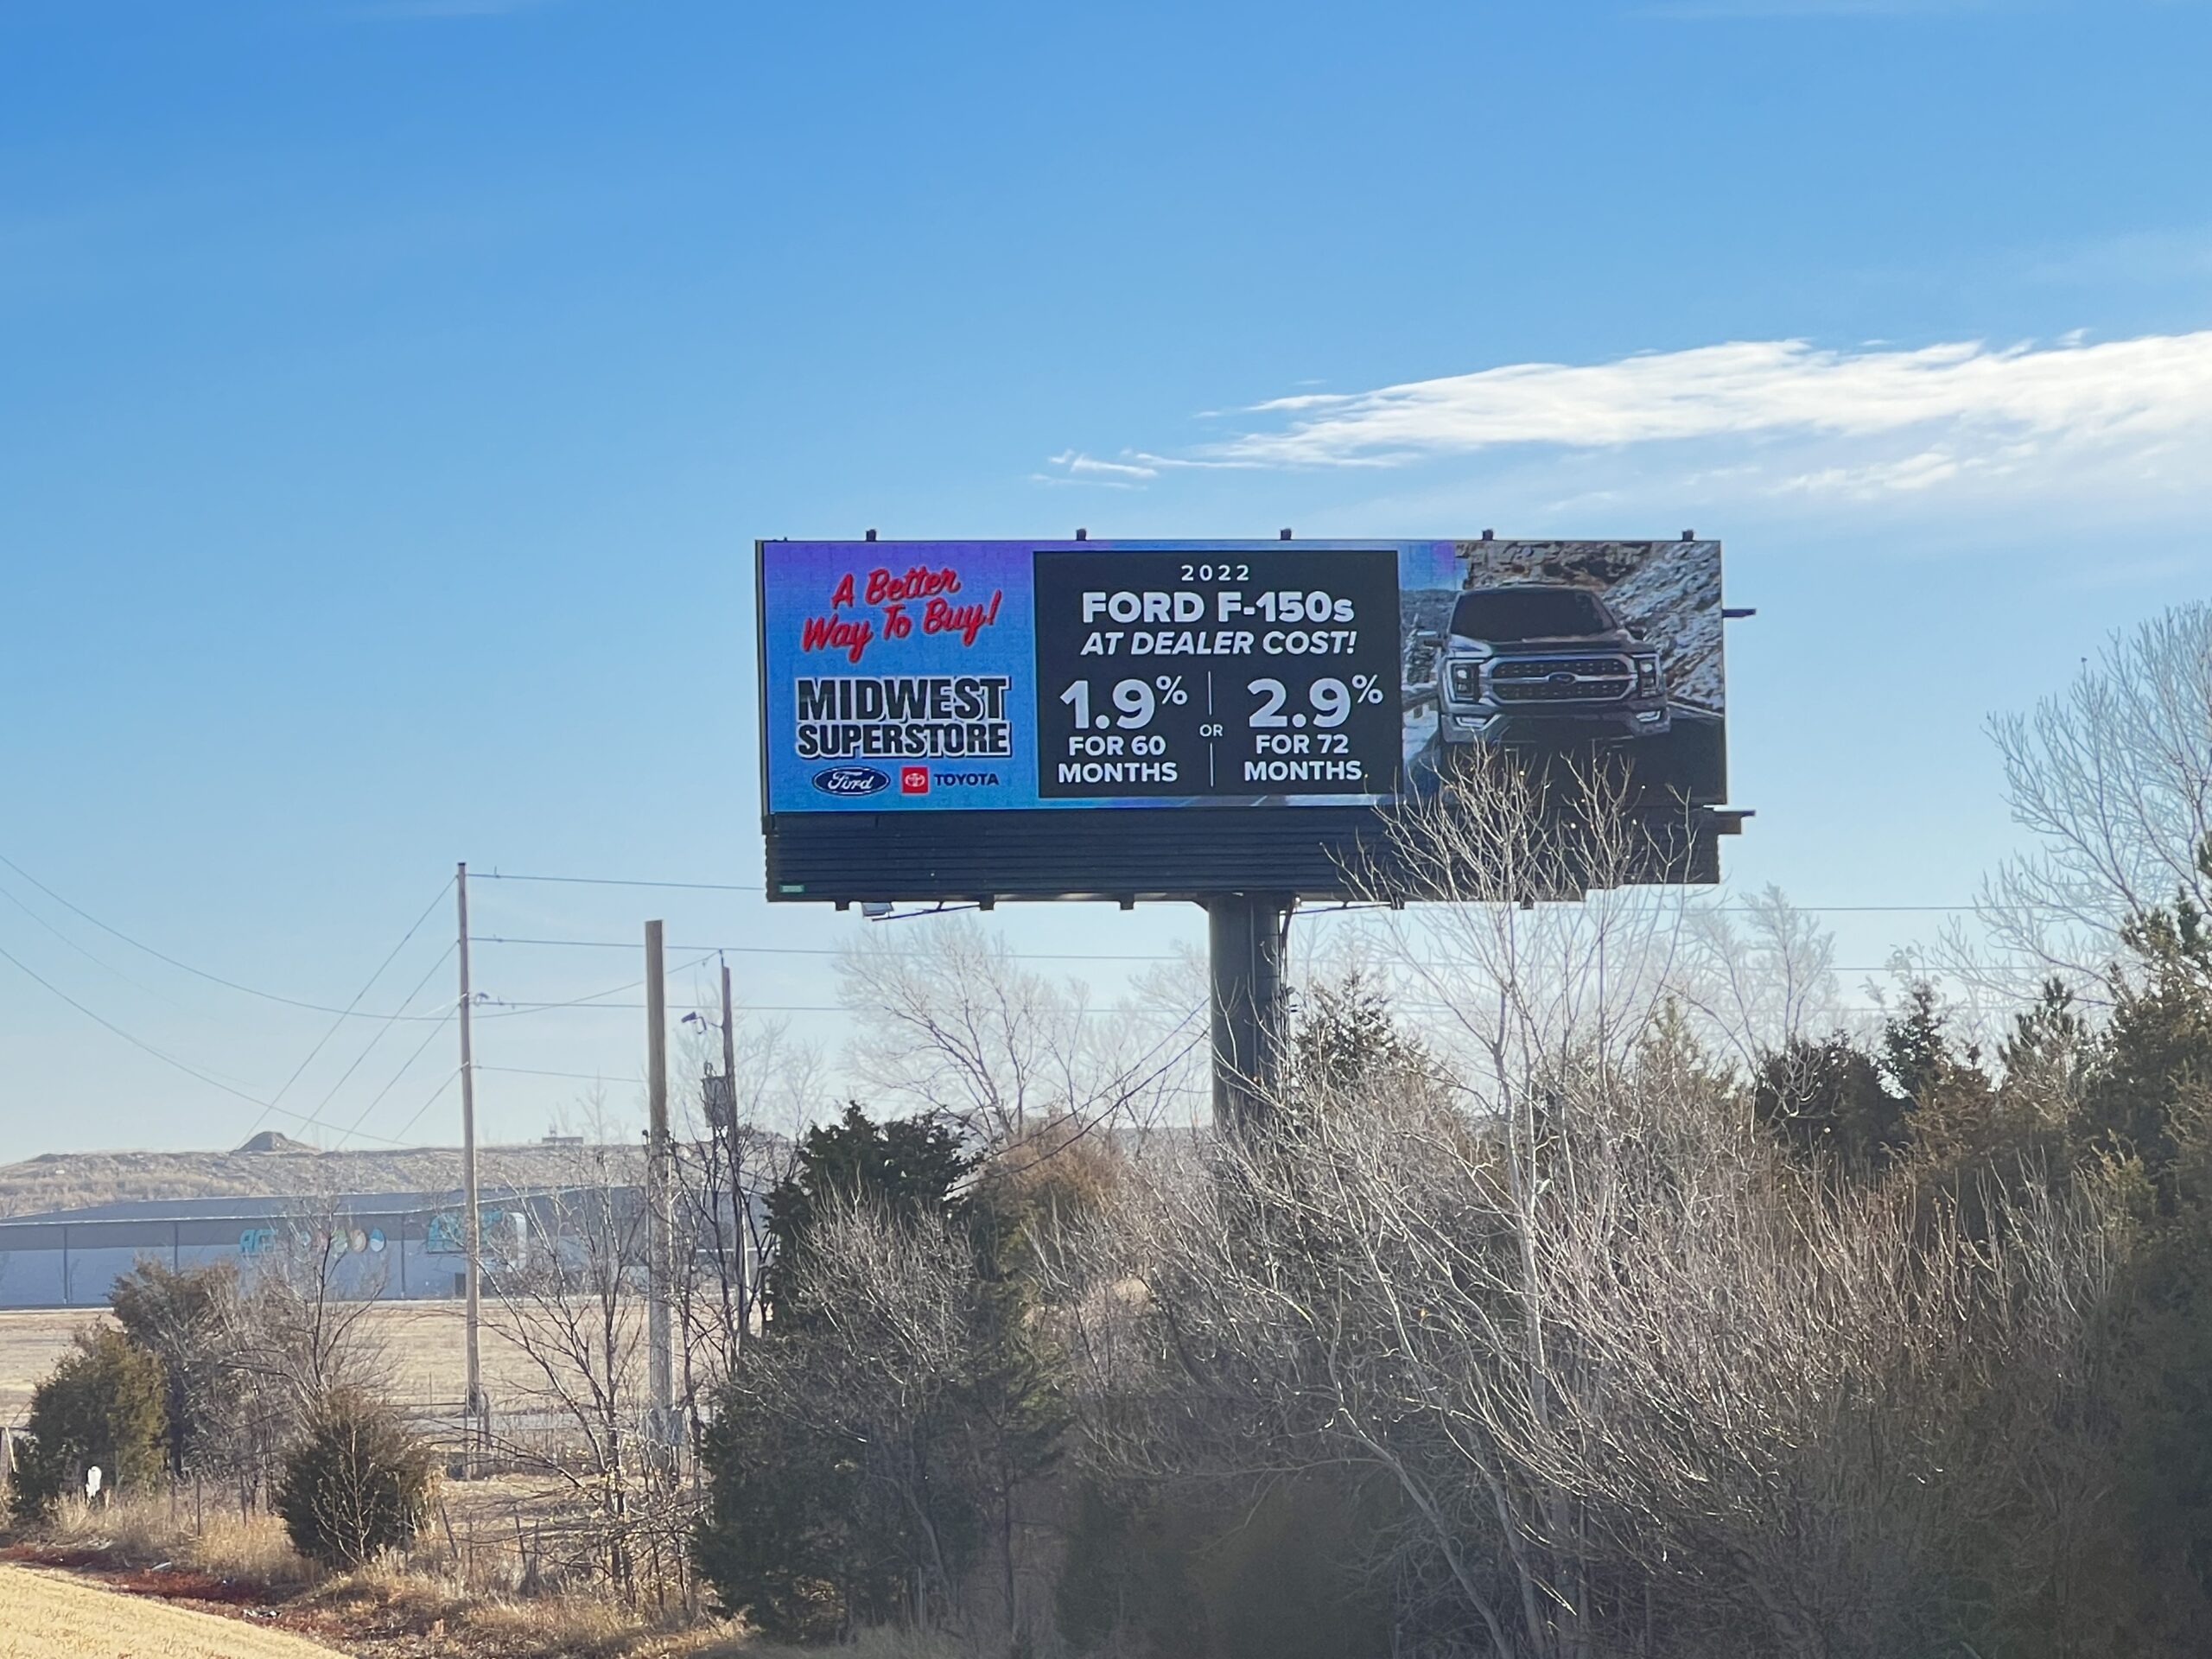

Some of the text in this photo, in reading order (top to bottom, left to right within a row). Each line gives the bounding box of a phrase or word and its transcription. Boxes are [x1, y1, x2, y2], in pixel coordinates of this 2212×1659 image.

[1180, 564, 1250, 582] 2022
[831, 566, 961, 608] A Better
[1082, 591, 1355, 623] FORD F-150s
[801, 589, 1001, 664] Way To Buy!
[1080, 631, 1357, 655] AT DEALER COST!
[796, 677, 1011, 722] MIDWEST
[1059, 675, 1188, 729] 1.9%
[1247, 674, 1383, 728] 2.9%
[796, 721, 1012, 760] SUPERSTORE
[1199, 724, 1223, 737] OR
[1068, 735, 1166, 756] FOR 60
[1255, 734, 1349, 754] FOR 72
[933, 772, 1000, 786] TOYOTA
[1058, 762, 1179, 783] MONTHS
[1244, 760, 1363, 781] MONTHS
